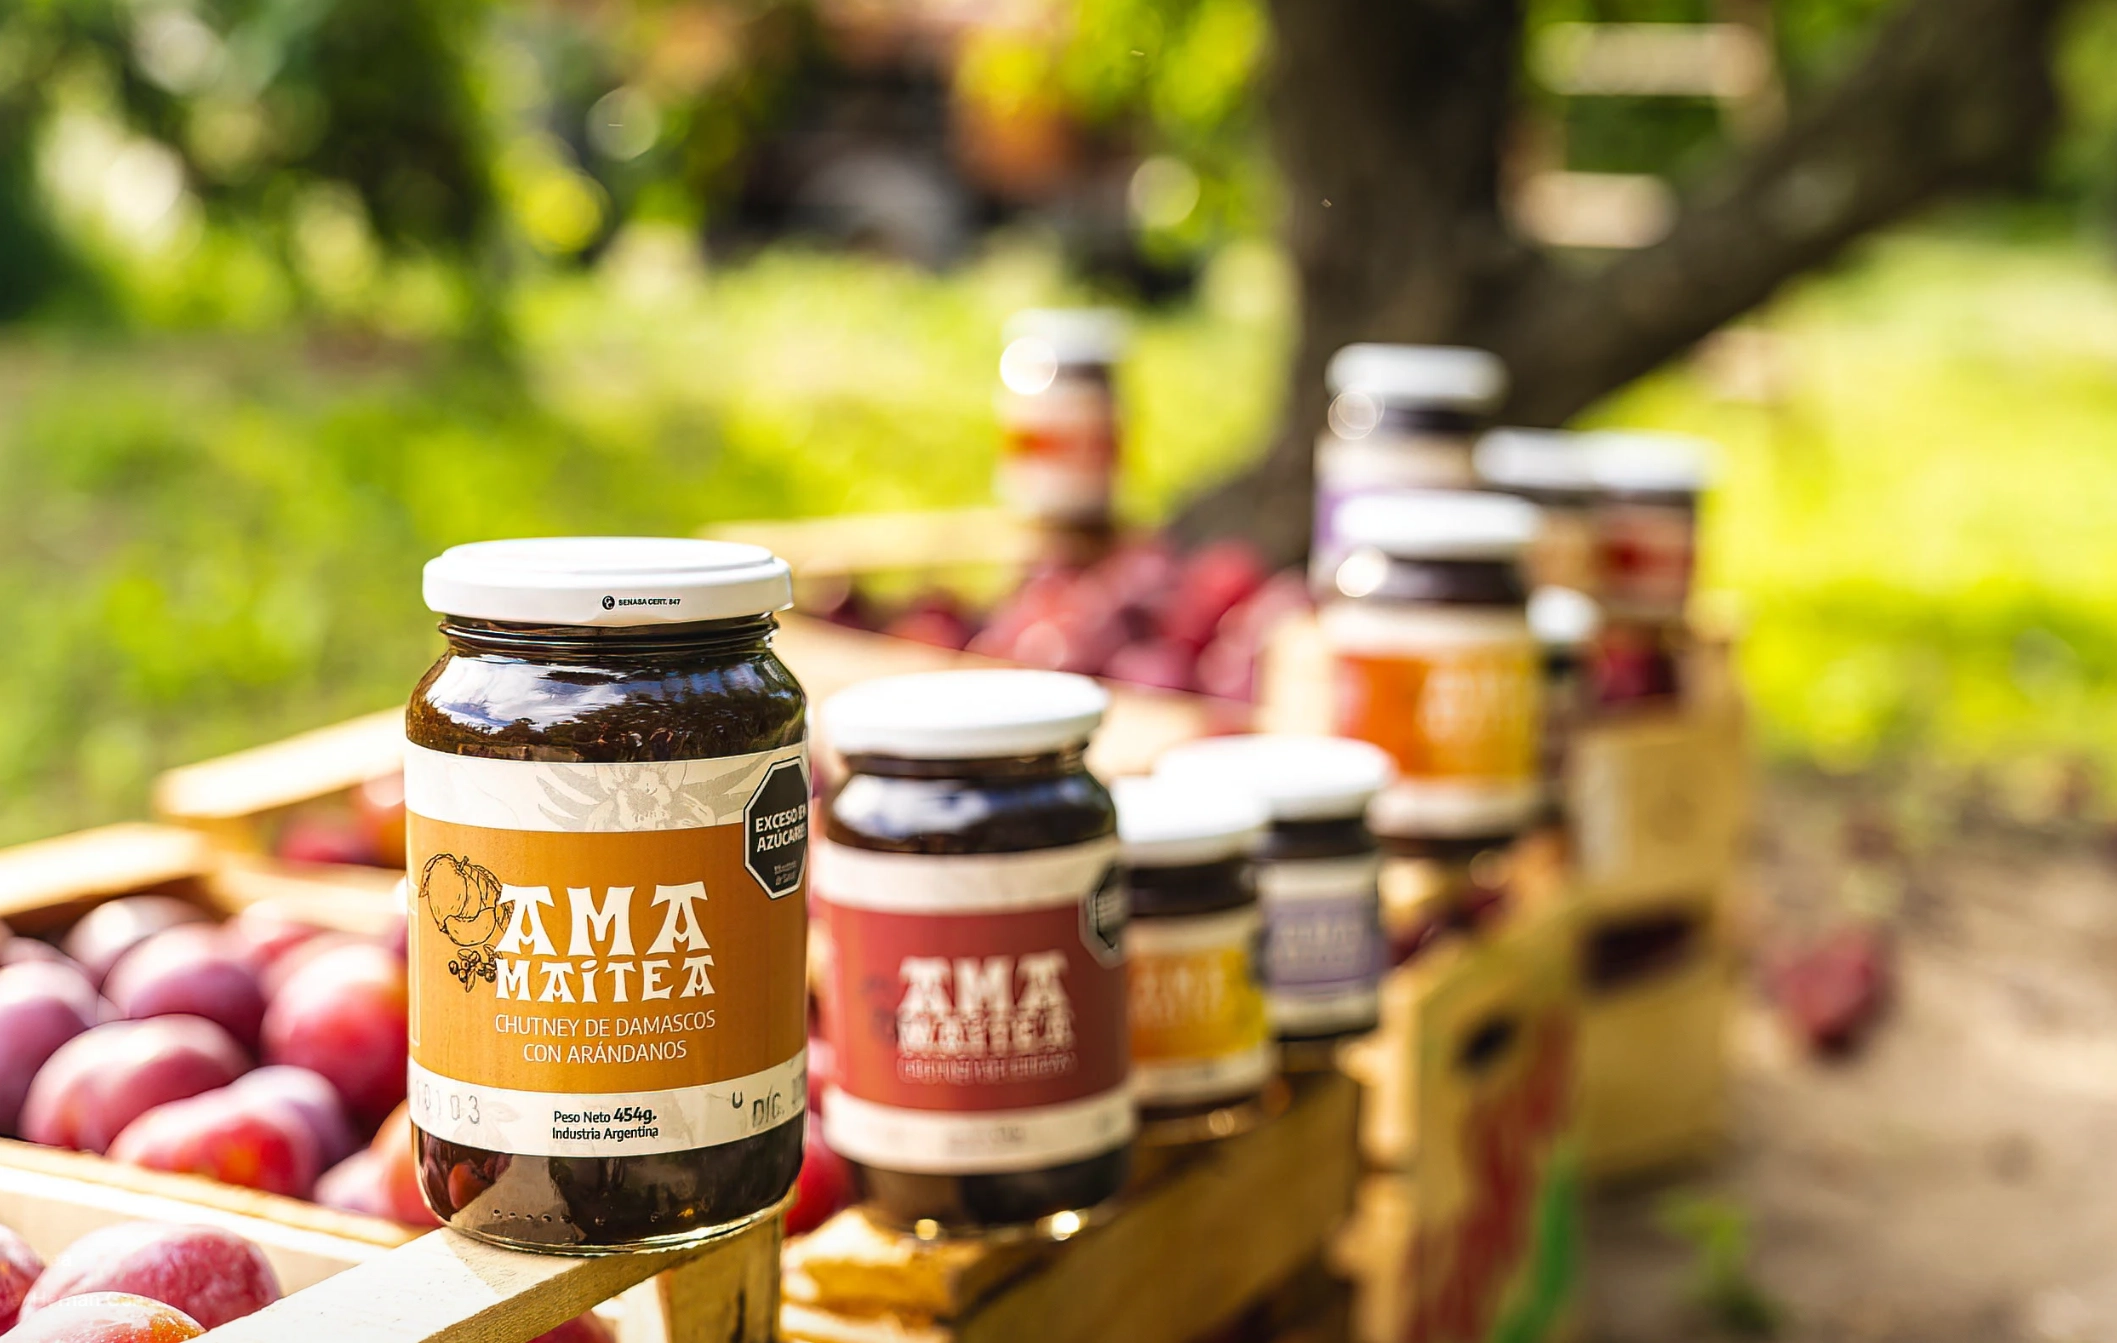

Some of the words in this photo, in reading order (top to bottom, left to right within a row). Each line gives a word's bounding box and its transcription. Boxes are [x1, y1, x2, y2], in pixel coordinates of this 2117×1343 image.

[619, 597, 647, 606] SENASA
[648, 598, 667, 606] CERT.
[669, 598, 681, 606] 847
[756, 808, 798, 833] EXCESO
[757, 823, 807, 853] AZÚCAR
[496, 881, 711, 956] AMA
[896, 951, 1073, 1018] AMA
[495, 1014, 580, 1037] CHUTNEY
[585, 1018, 611, 1037] DE
[616, 1009, 716, 1037] DAMASCOS
[523, 1043, 562, 1062] CON
[567, 1039, 688, 1064] ARÁNDANOS
[554, 1110, 581, 1123] Peso
[583, 1111, 611, 1123] Neto
[613, 1107, 657, 1125] 454g.
[552, 1126, 601, 1140] Industria
[603, 1125, 659, 1142] Argentina
